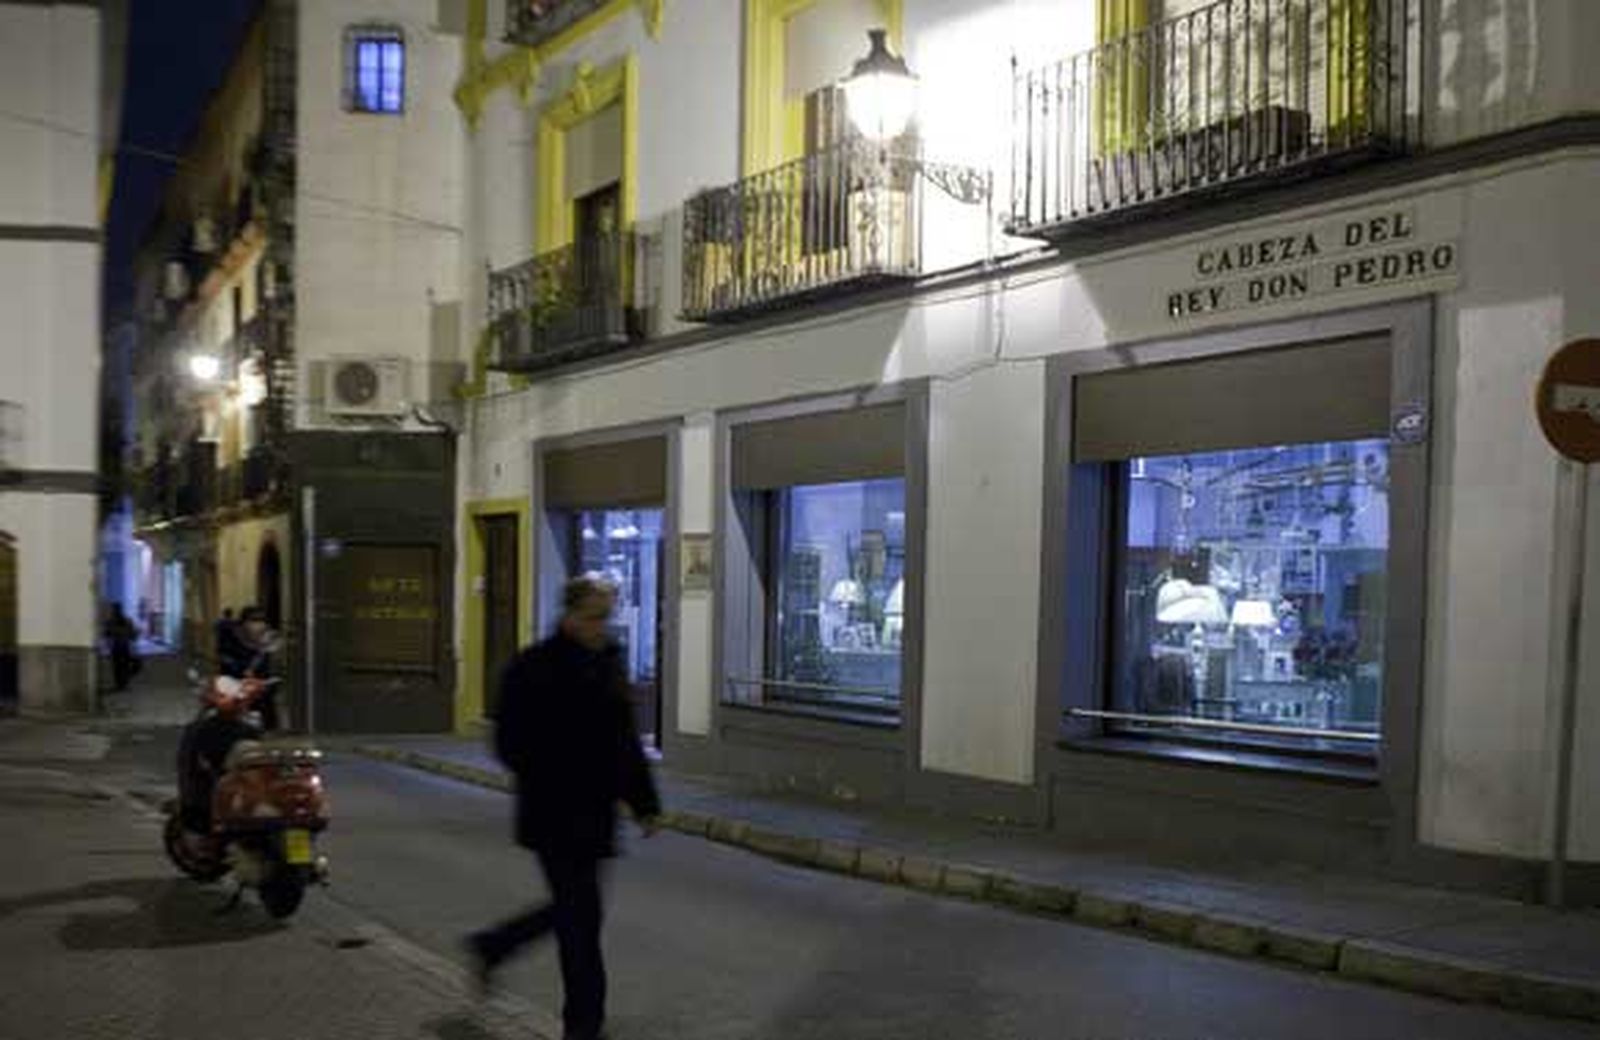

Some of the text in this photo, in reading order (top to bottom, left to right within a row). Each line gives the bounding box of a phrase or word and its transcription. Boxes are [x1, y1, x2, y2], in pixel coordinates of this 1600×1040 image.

[1197, 212, 1412, 275] CABEZA DEL
[1168, 245, 1453, 318] REY DON PEDRO
